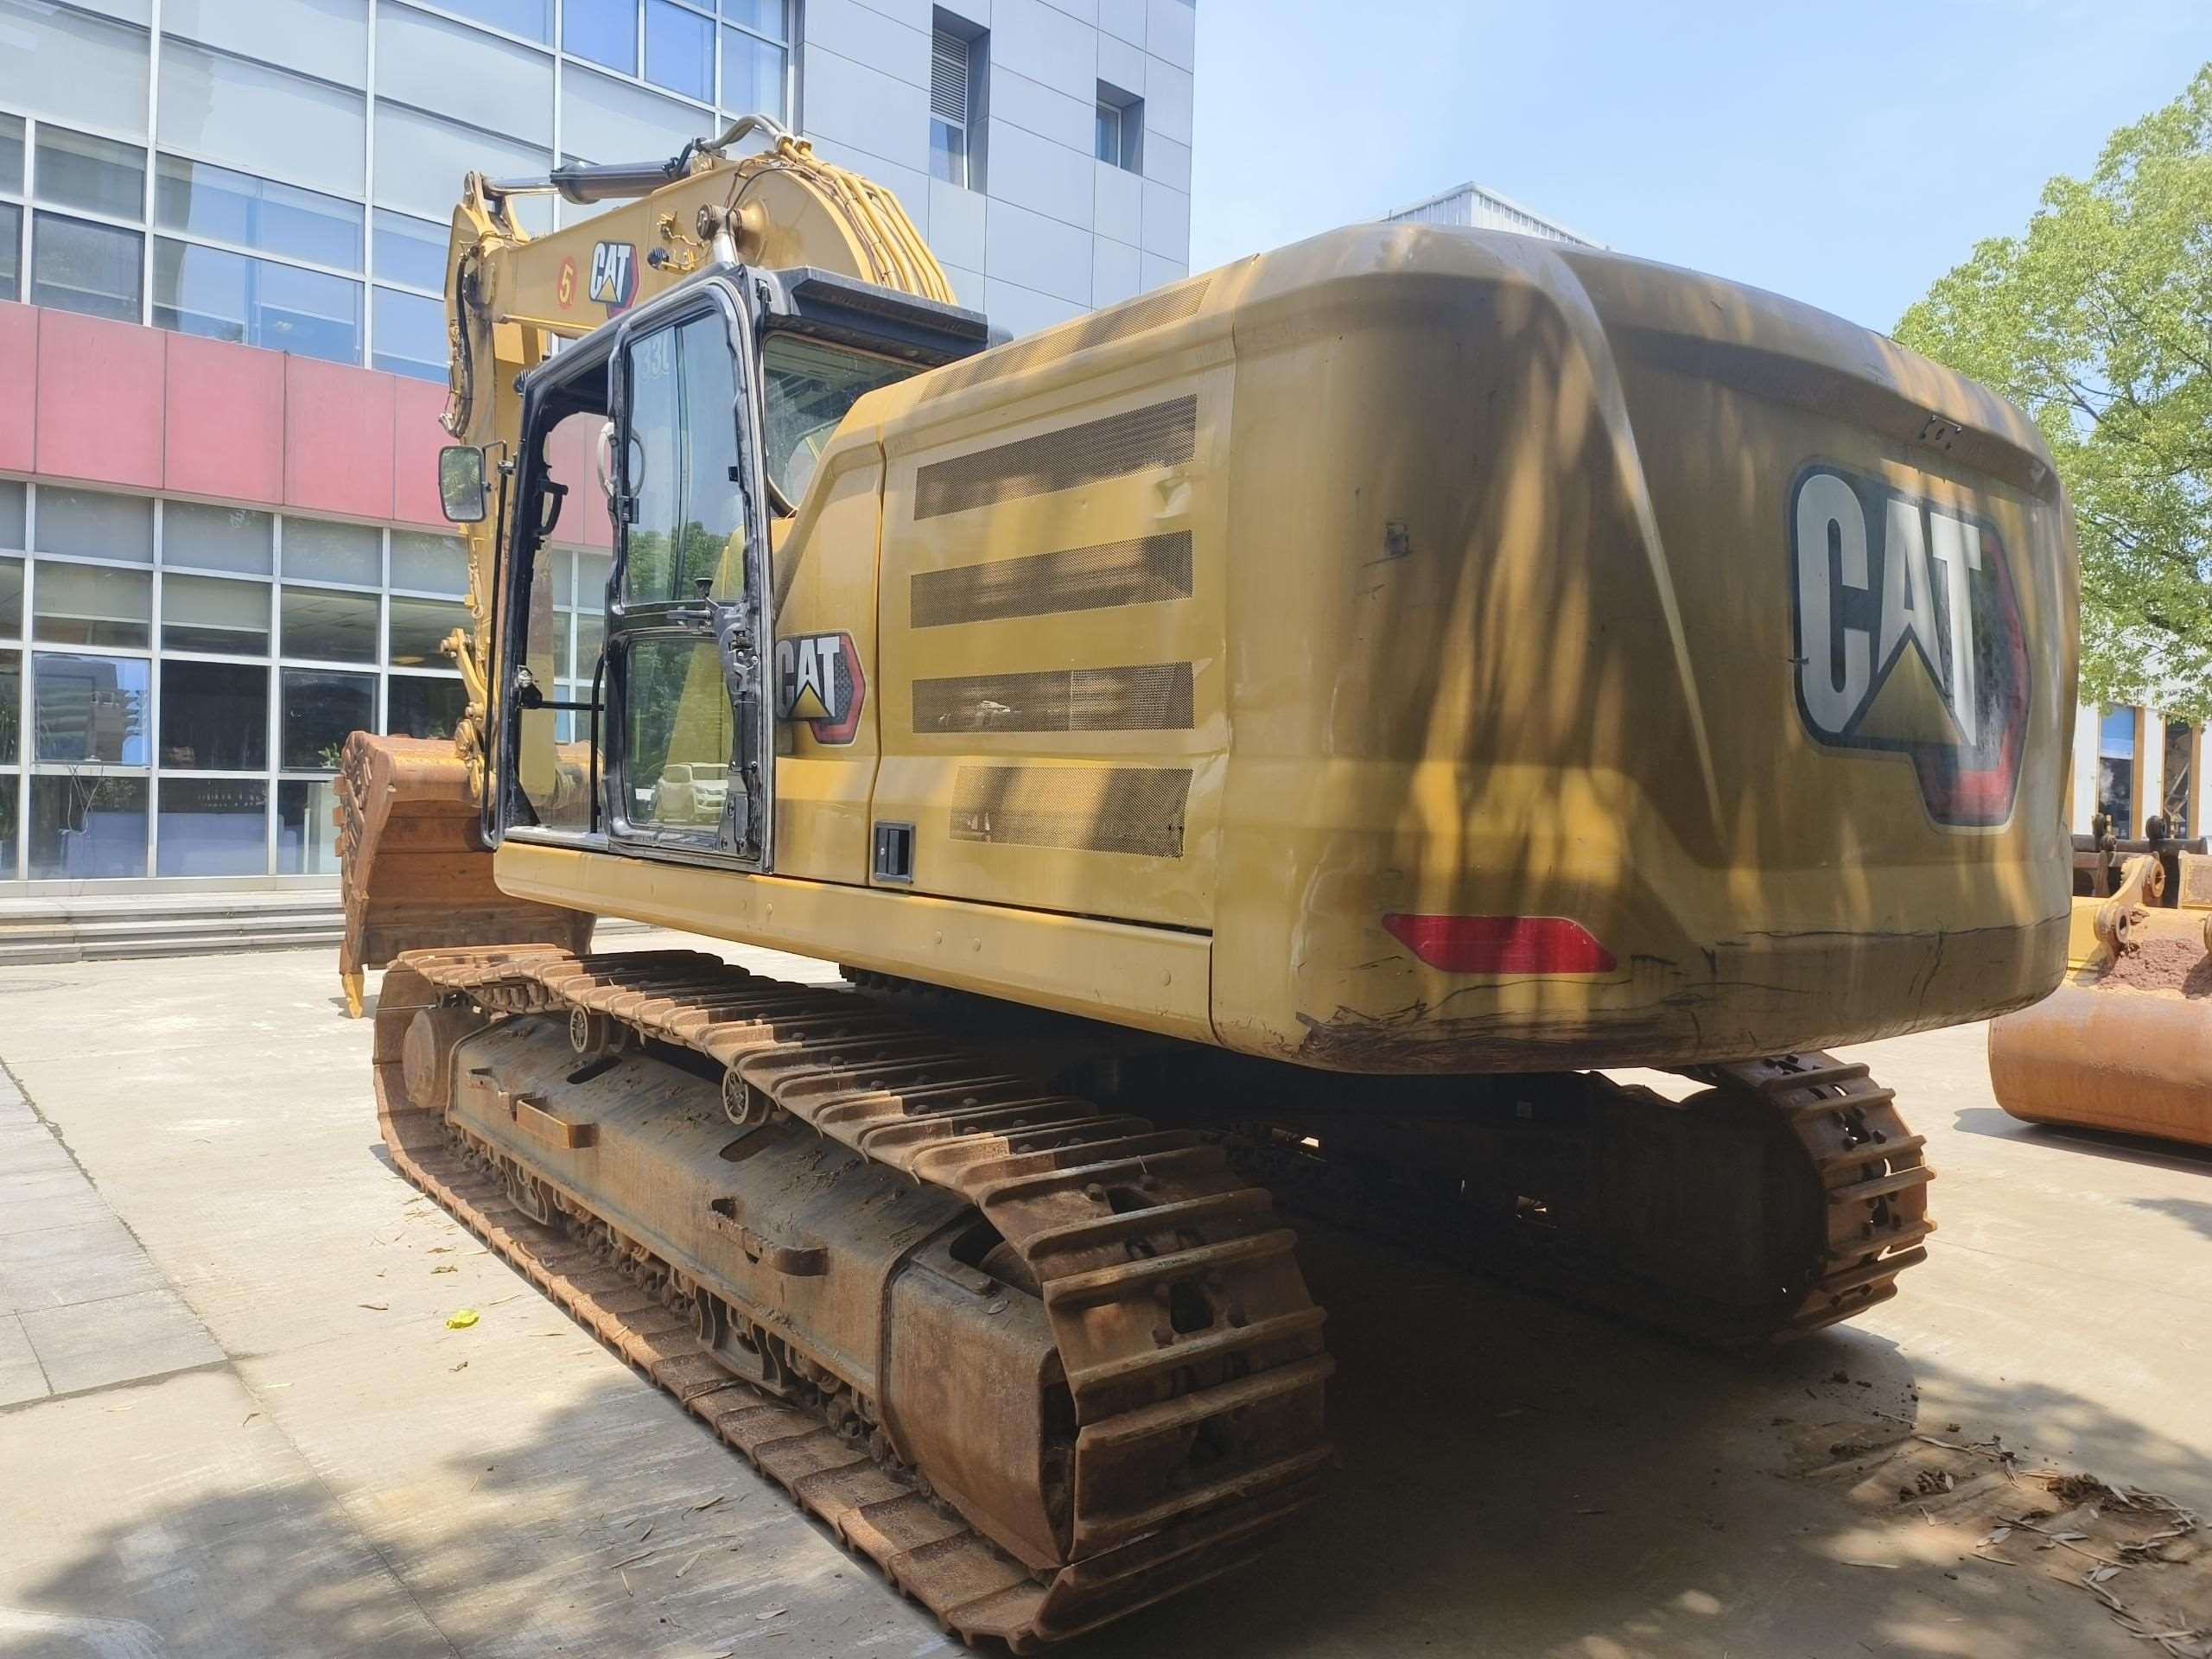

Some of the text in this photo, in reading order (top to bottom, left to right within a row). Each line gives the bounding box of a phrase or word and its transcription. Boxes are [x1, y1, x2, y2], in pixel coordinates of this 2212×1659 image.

[590, 242, 631, 302] CAT
[1796, 474, 1982, 747] CAT
[776, 636, 840, 718] CAT
